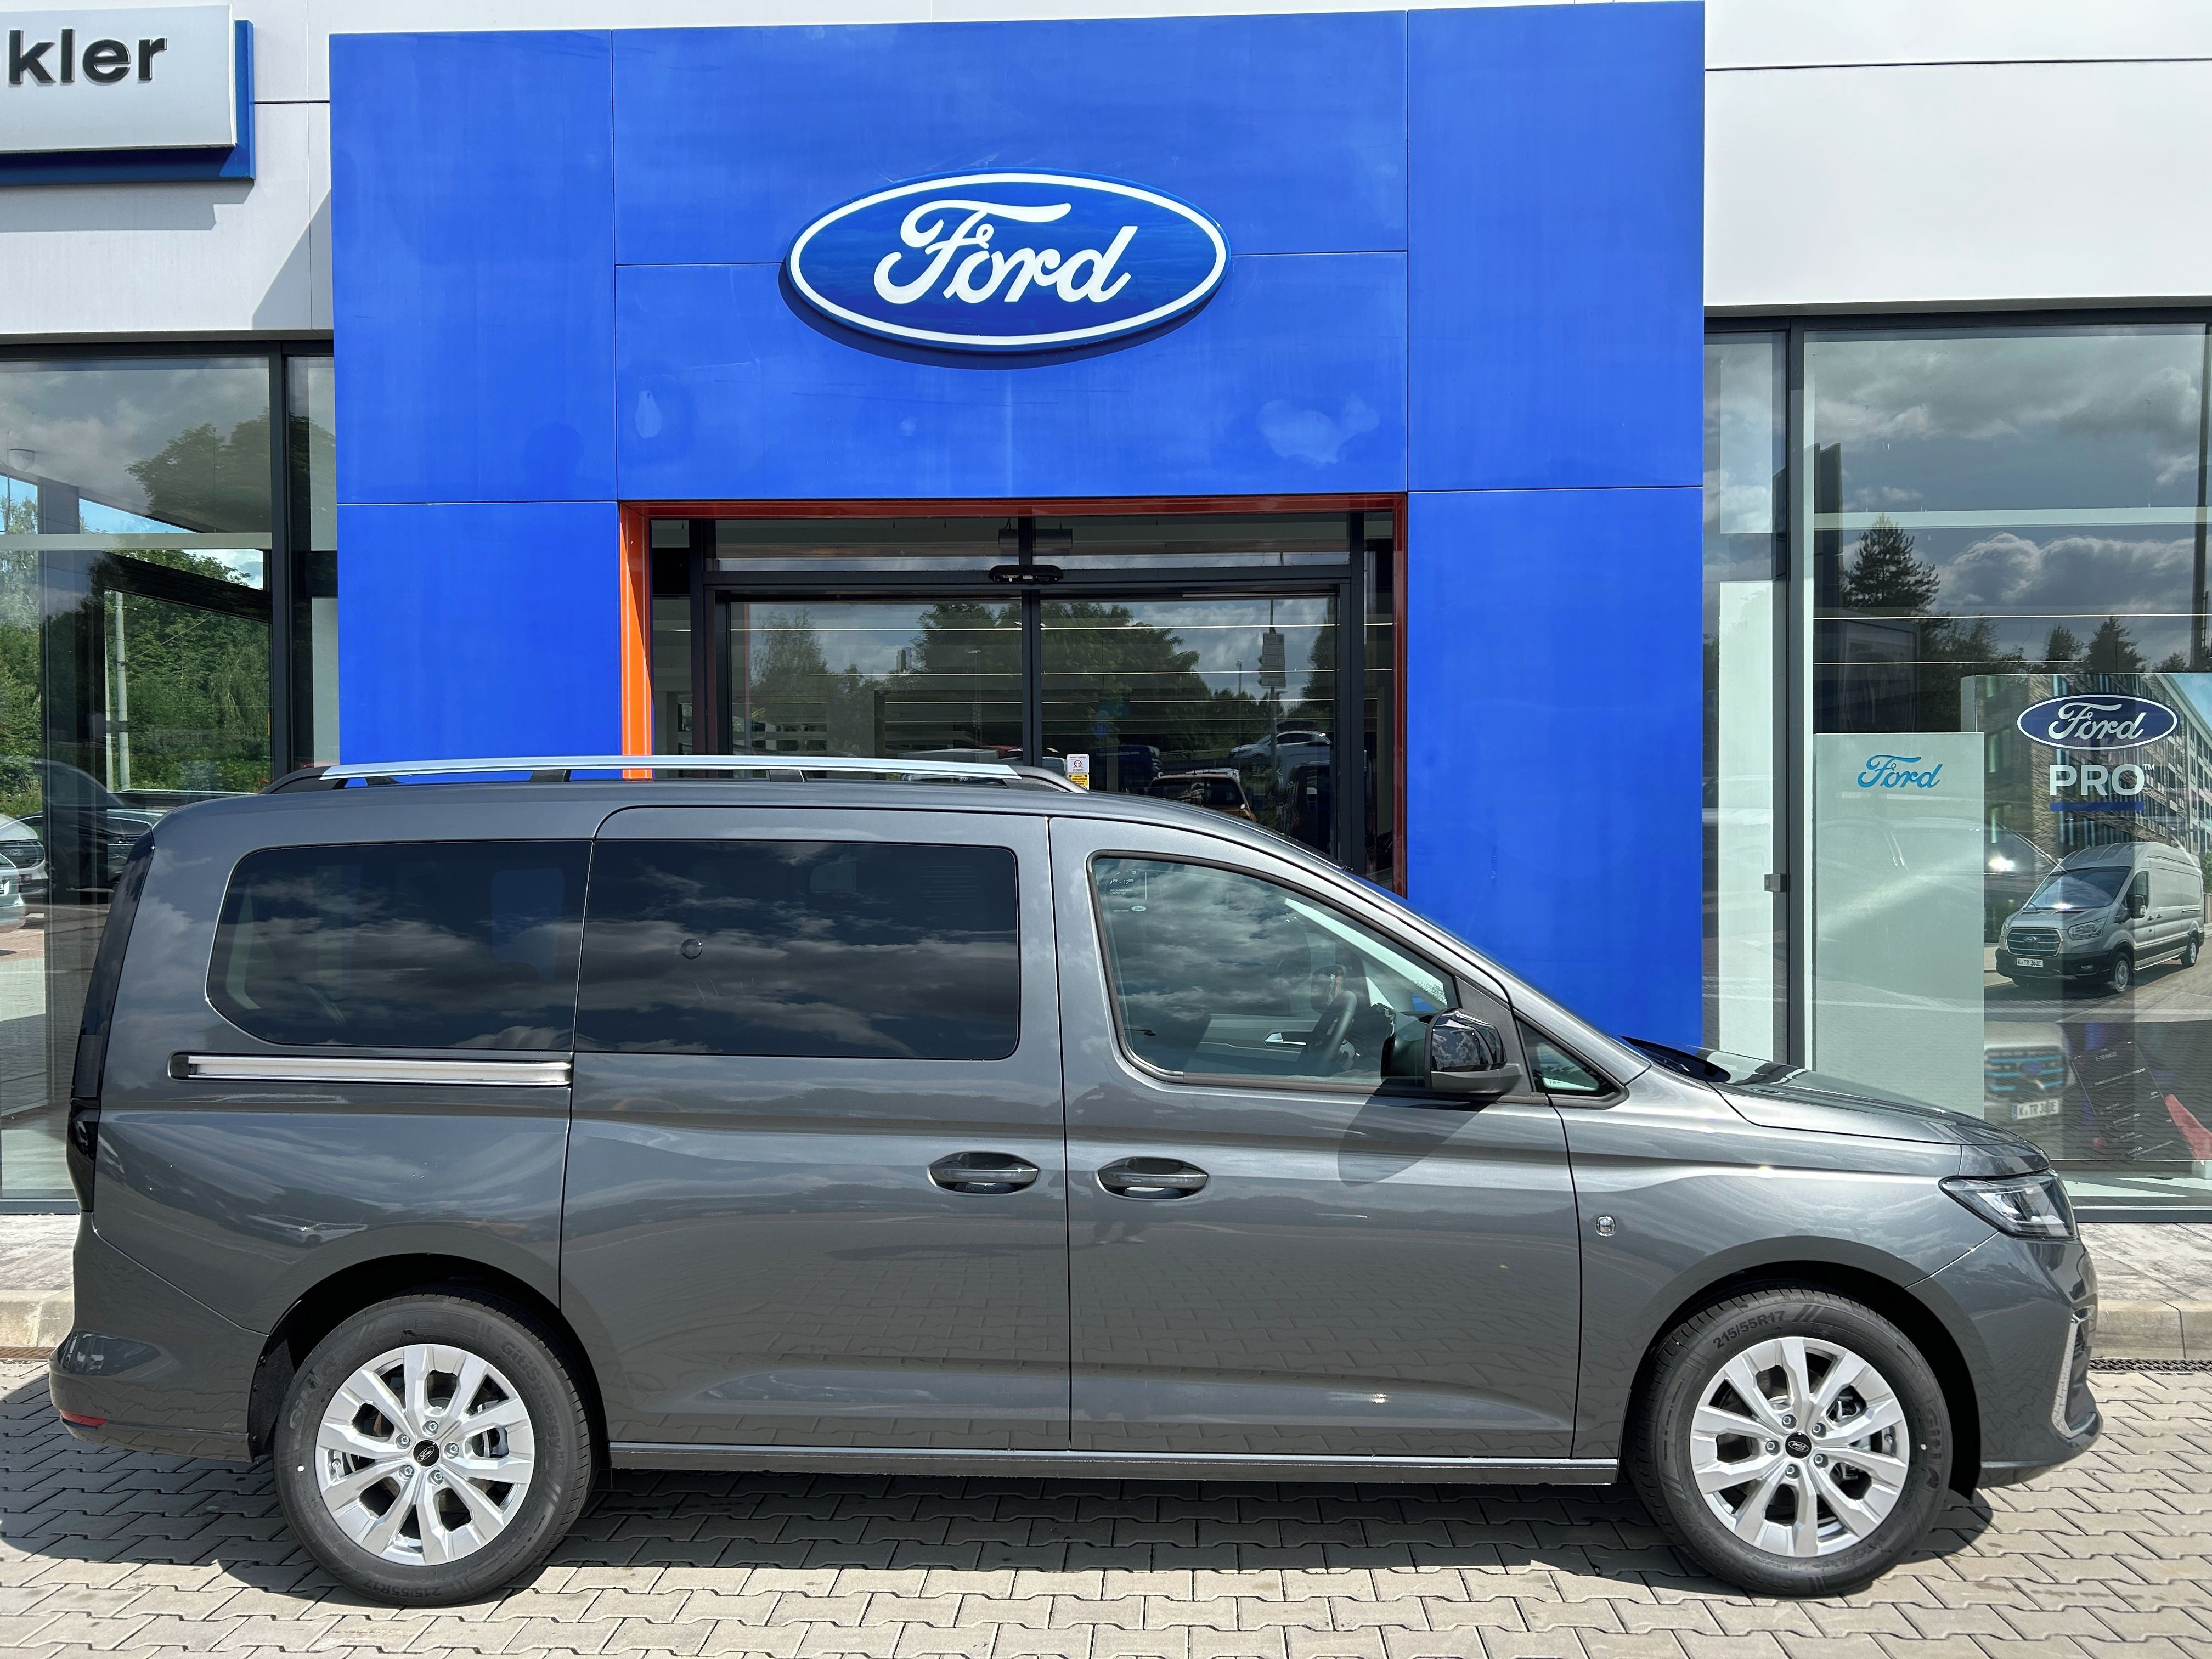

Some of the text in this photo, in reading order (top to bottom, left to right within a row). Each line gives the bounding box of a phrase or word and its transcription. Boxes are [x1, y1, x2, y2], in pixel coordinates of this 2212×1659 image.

[9, 28, 167, 84] kler
[873, 199, 1138, 304] Ford
[2047, 702, 2147, 740] Ford
[1857, 754, 1943, 788] Ford
[1713, 1310, 1785, 1349] 215/55R17
